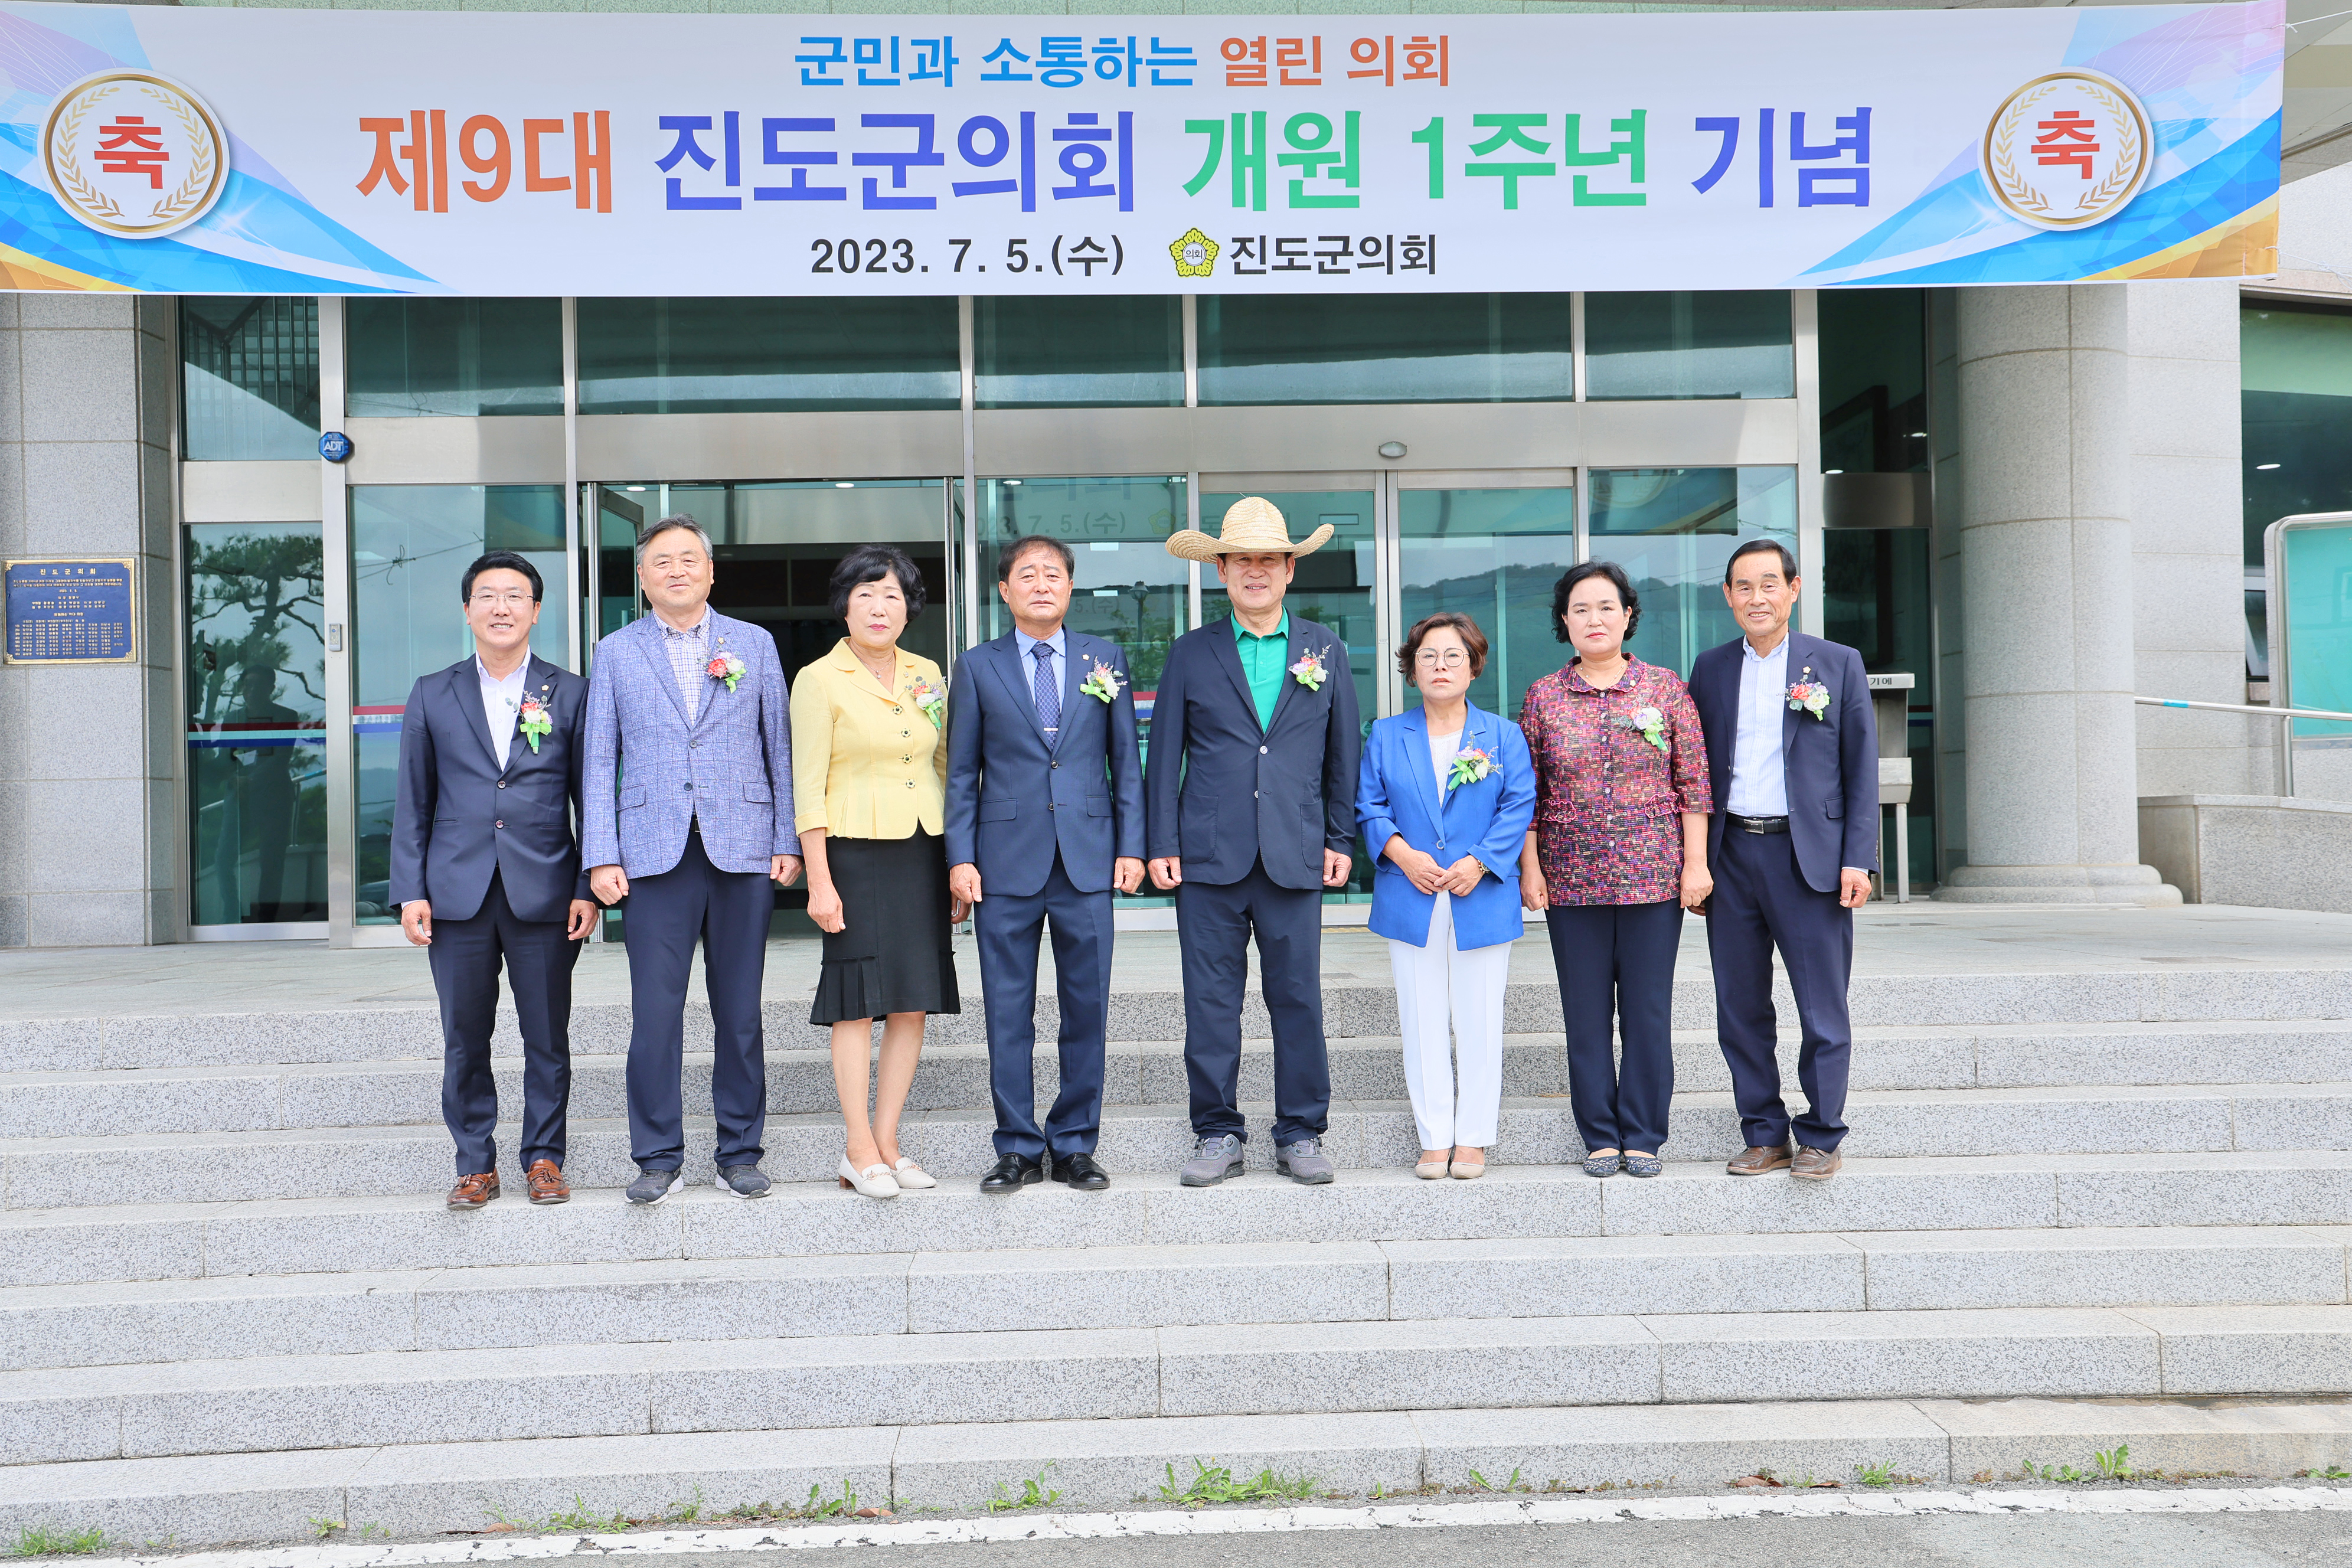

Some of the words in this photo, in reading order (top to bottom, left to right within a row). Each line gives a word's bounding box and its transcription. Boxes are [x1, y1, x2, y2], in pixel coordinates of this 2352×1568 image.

[795, 36, 959, 87] 군민과
[981, 36, 1197, 87] 소통하는
[1221, 36, 1321, 86] 열린
[1347, 35, 1448, 86] 의회
[94, 116, 170, 190] 축
[355, 110, 612, 213] 제9대
[654, 111, 1133, 212] 진도군의회
[1182, 111, 1361, 211] 개원
[1412, 109, 1647, 210] 1주년
[1691, 107, 1871, 207] 기념
[2031, 110, 2100, 179] 축
[812, 239, 928, 273] 2023.
[949, 239, 985, 272] 7.
[1007, 235, 1123, 276] 5.(수)
[1185, 249, 1202, 259] 의회
[1230, 234, 1435, 275] 진도군의회
[324, 441, 344, 451] ADT
